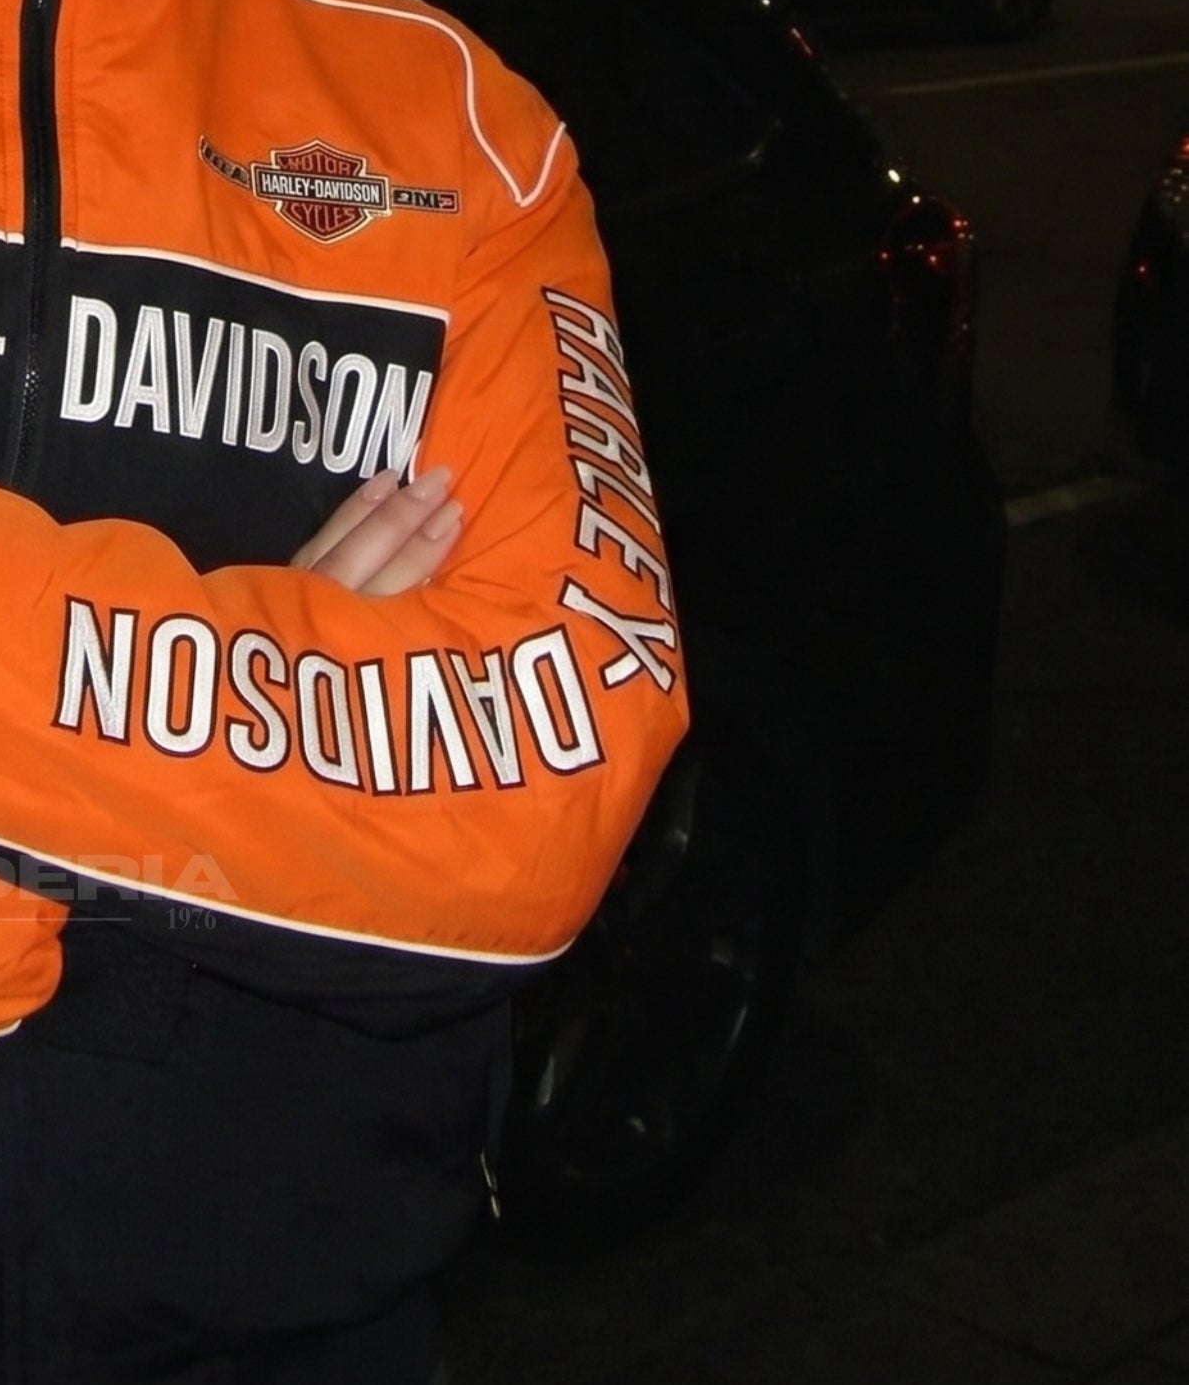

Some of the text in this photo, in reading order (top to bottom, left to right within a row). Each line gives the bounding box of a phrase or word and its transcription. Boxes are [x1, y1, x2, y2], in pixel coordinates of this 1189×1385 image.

[261, 172, 380, 204] HARLEY-DAVIDSON
[290, 202, 356, 233] CYCLES
[59, 295, 433, 484] DAVIDSON
